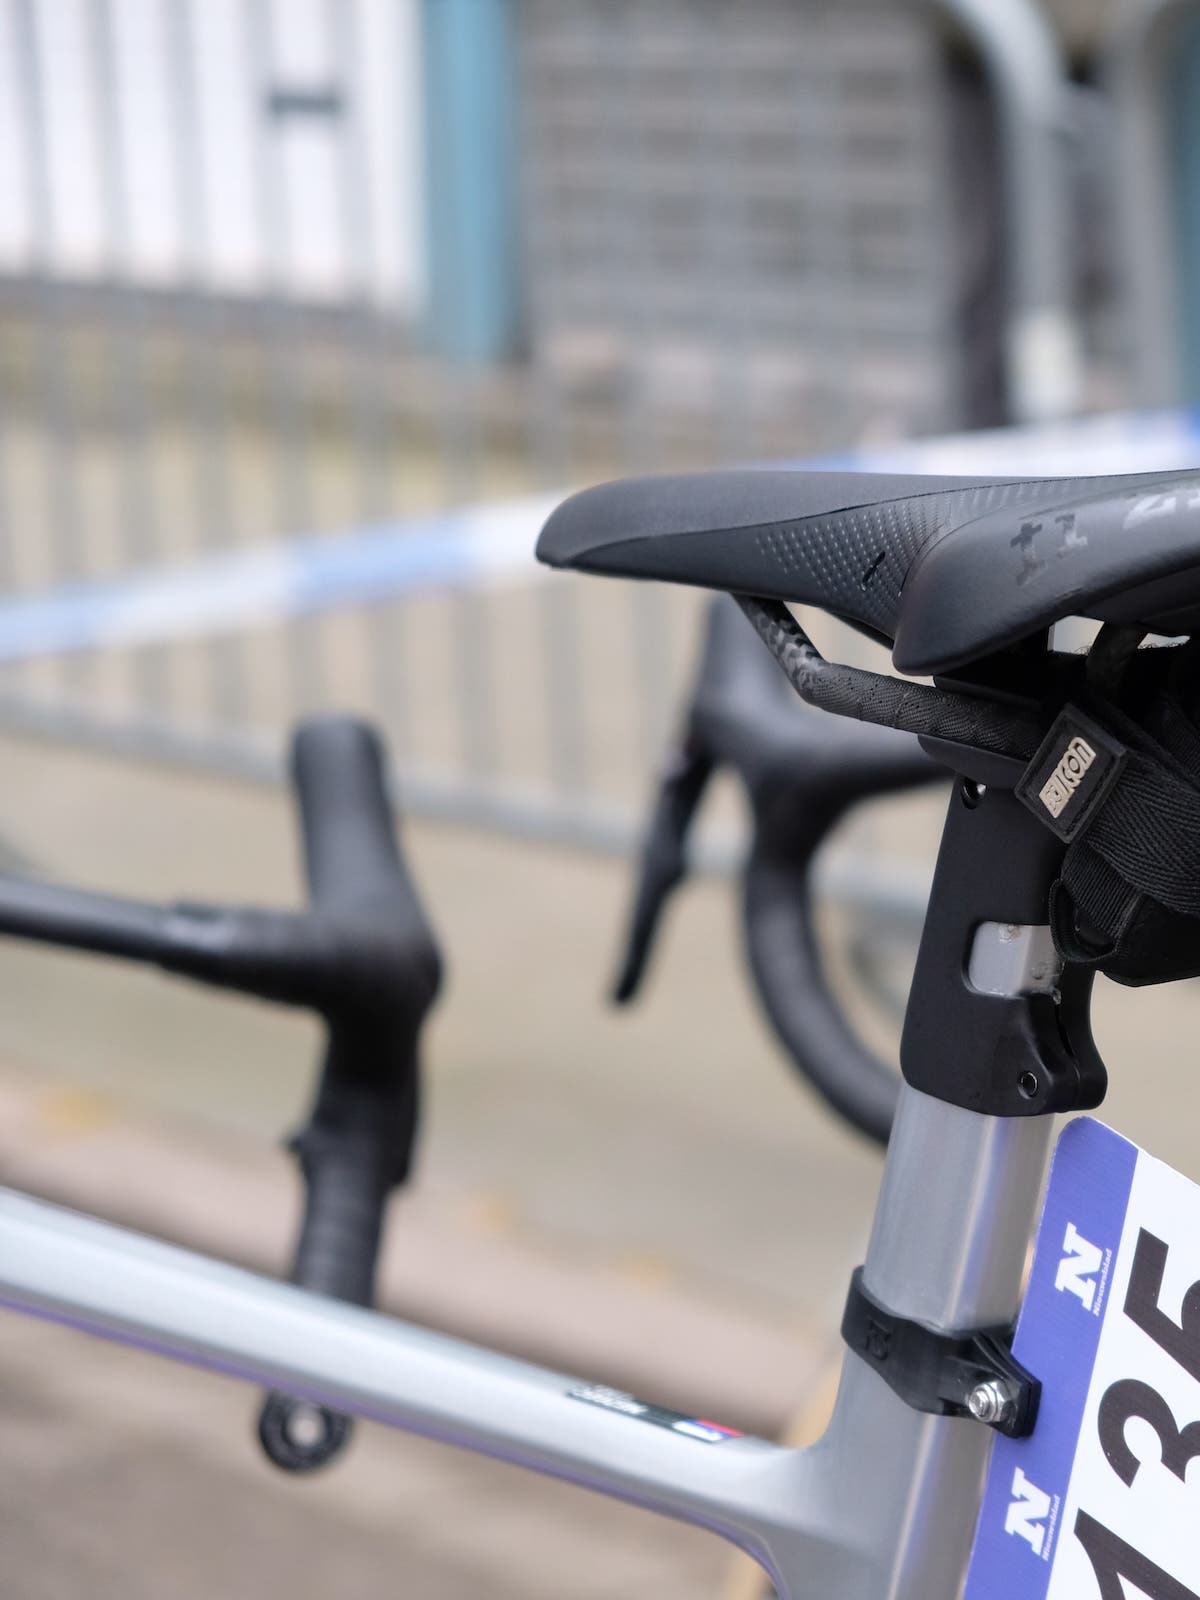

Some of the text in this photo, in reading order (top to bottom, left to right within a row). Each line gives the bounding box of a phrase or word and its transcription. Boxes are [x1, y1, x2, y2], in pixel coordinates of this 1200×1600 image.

[1054, 1222, 1104, 1312] N
[1092, 1248, 1113, 1317] Nieuwsblad
[1004, 1467, 1054, 1555] N
[1041, 1494, 1061, 1562] Nieuwsblad
